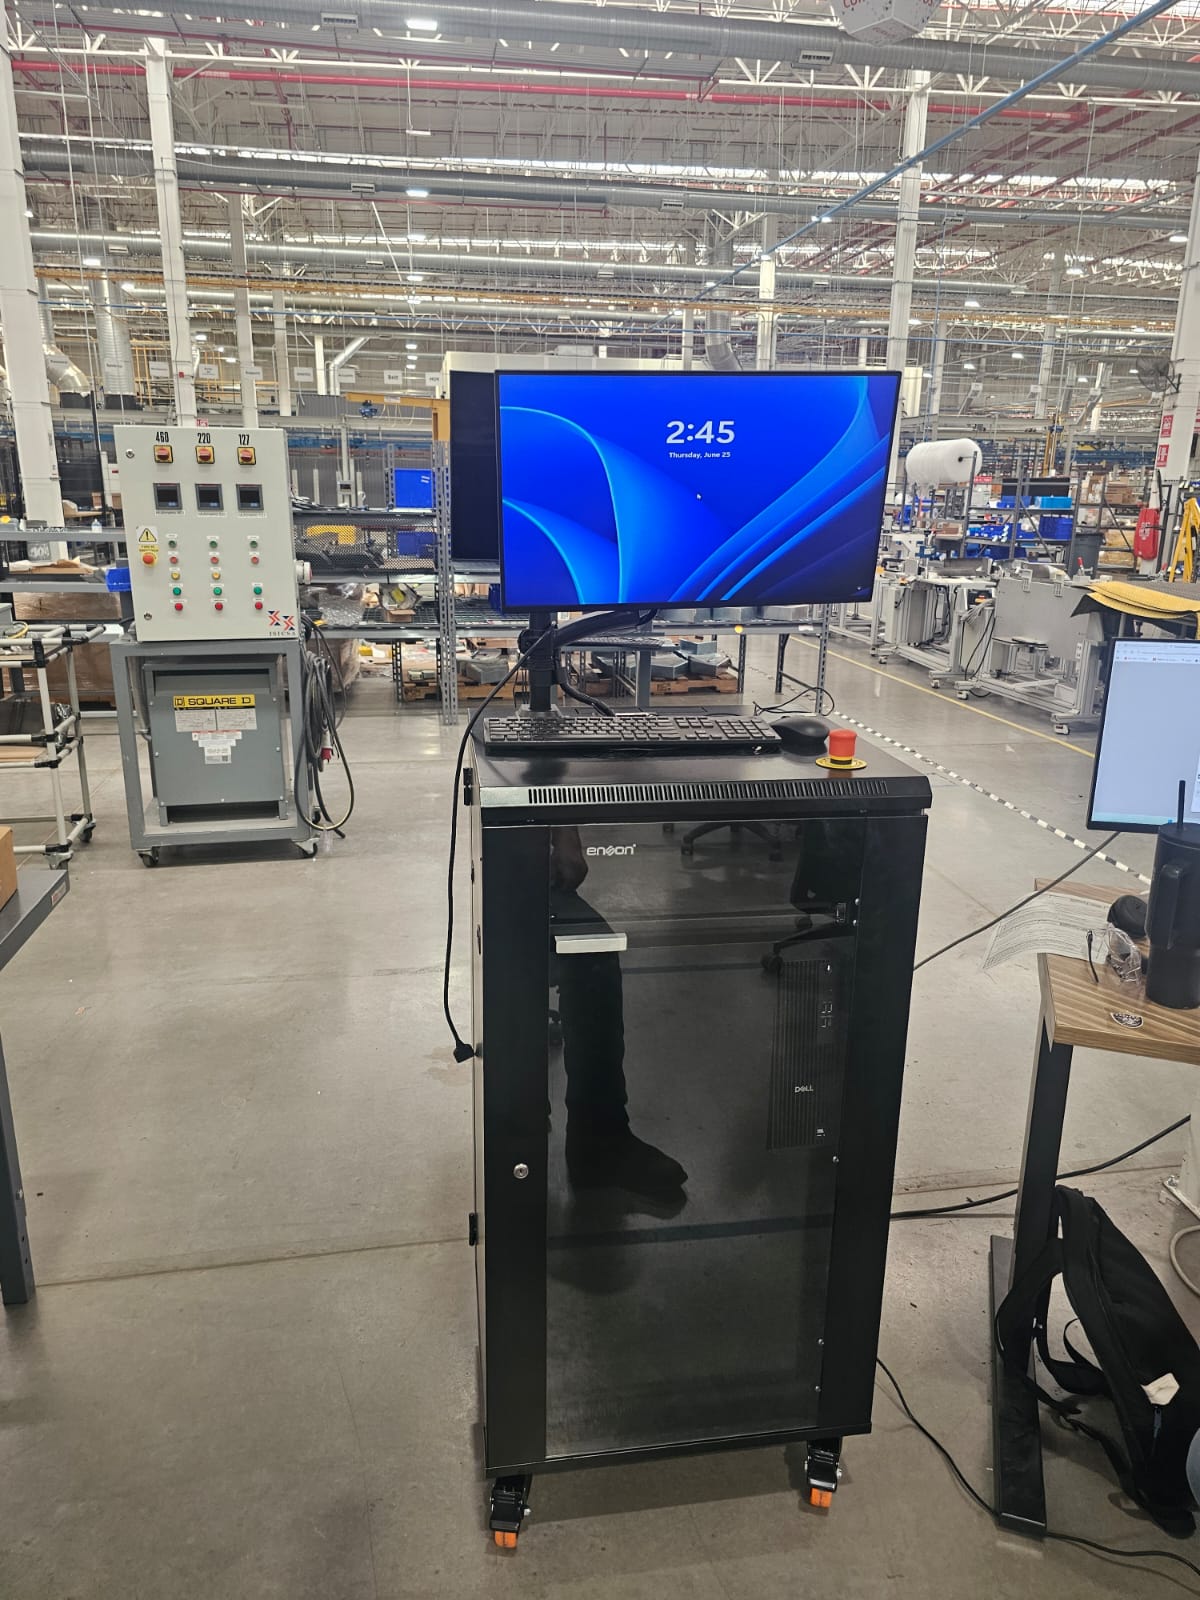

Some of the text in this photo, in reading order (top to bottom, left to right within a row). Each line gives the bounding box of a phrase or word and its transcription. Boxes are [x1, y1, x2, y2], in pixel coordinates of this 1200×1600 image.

[155, 431, 170, 443] 460
[197, 432, 211, 444] 220
[666, 420, 735, 444] 2:45
[238, 433, 250, 445] 127
[669, 451, 702, 459] Thursday,
[188, 697, 236, 705] SQUARE
[242, 697, 251, 705] D
[586, 844, 635, 857] enson
[794, 1084, 814, 1093] DELL
